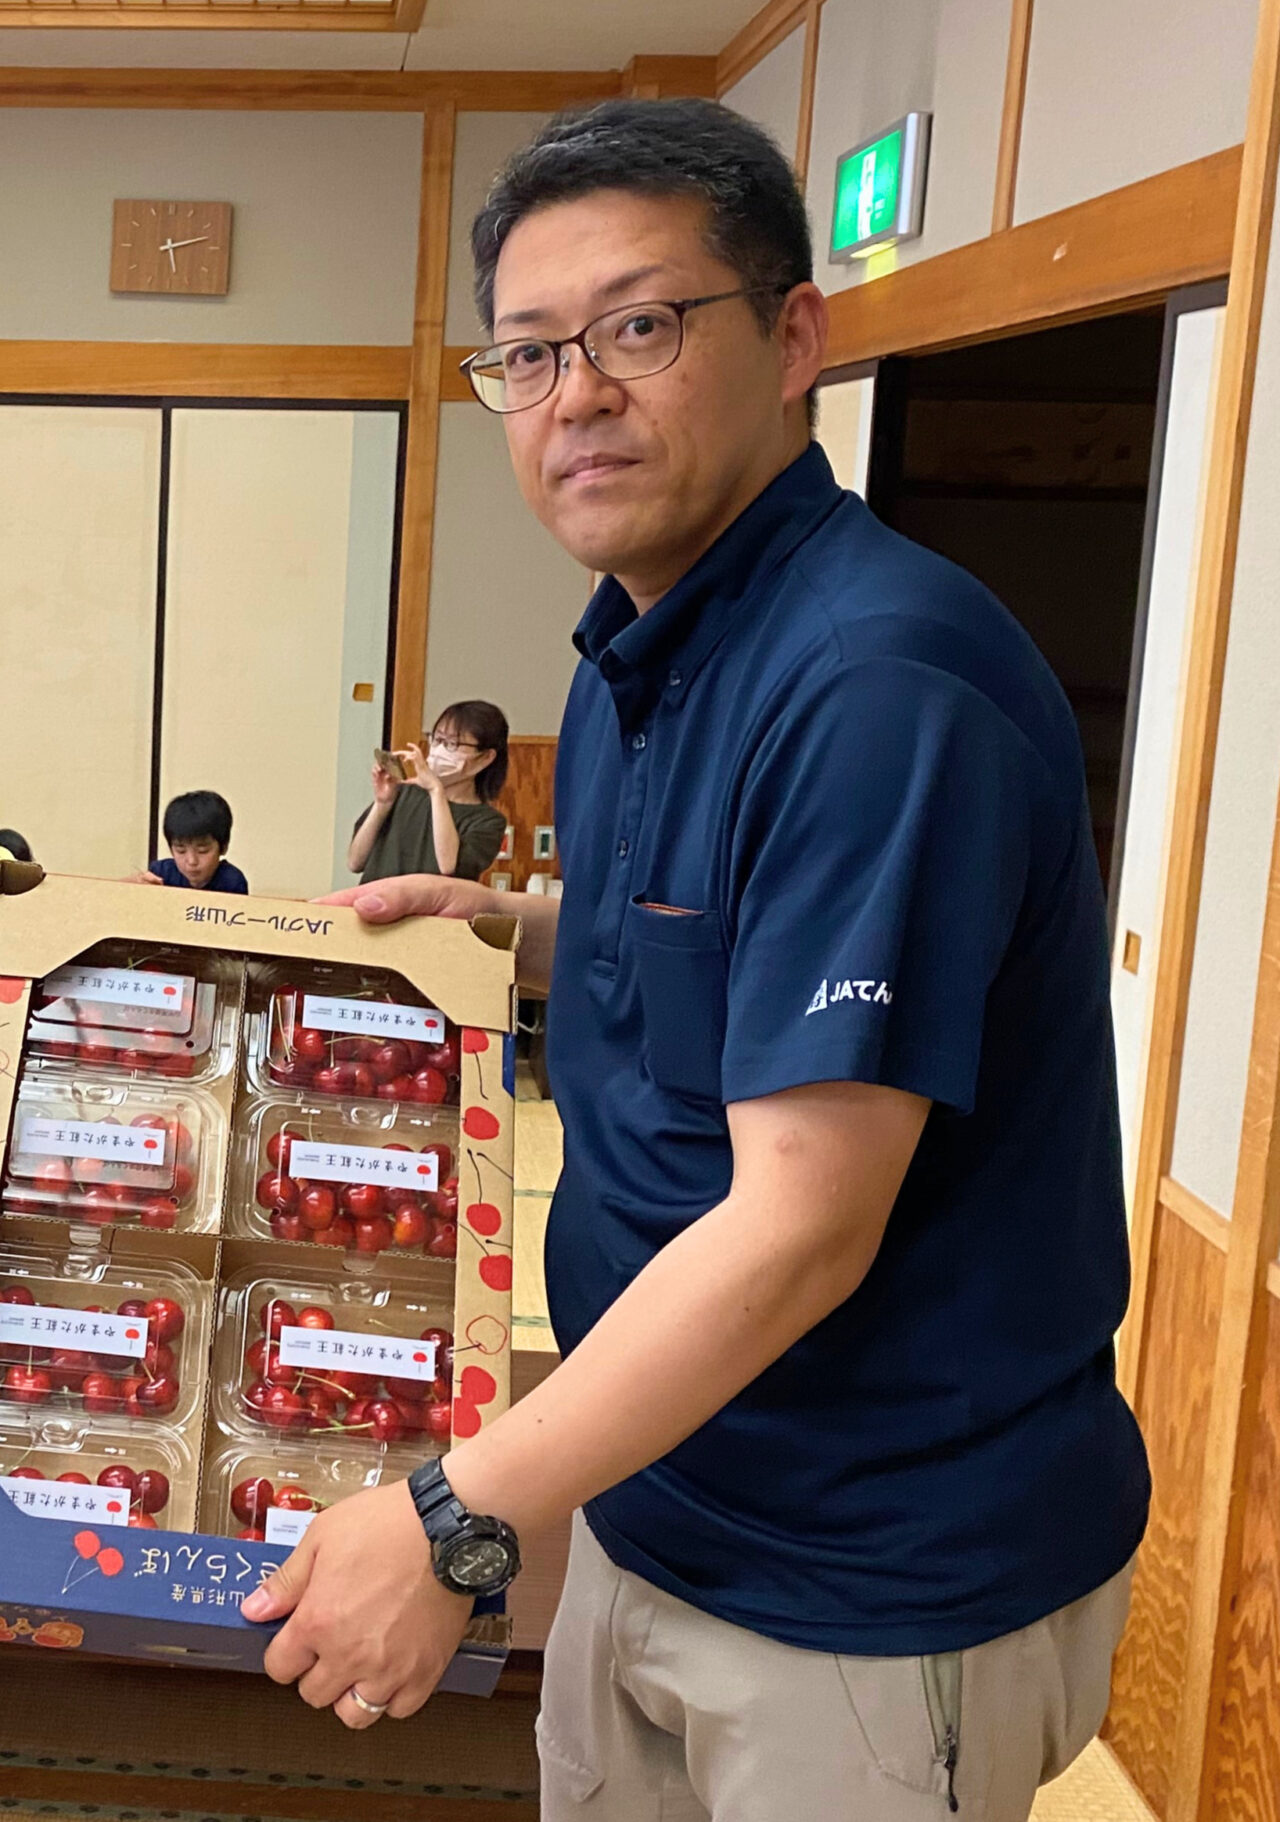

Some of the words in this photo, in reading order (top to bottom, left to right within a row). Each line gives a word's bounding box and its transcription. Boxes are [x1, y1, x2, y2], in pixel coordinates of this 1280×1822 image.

[186, 905, 334, 935] JAグループ山形
[77, 975, 155, 994] やまがた紅王
[338, 1007, 416, 1027] やまがた紅王
[54, 1129, 135, 1148] やまがた紅王
[325, 1153, 409, 1173] やまがた紅王
[29, 1317, 116, 1338] やまがた紅王
[316, 1339, 404, 1361] やまがた紅王
[8, 1489, 96, 1511] やまがた紅王
[171, 1583, 246, 1608] 山形県産
